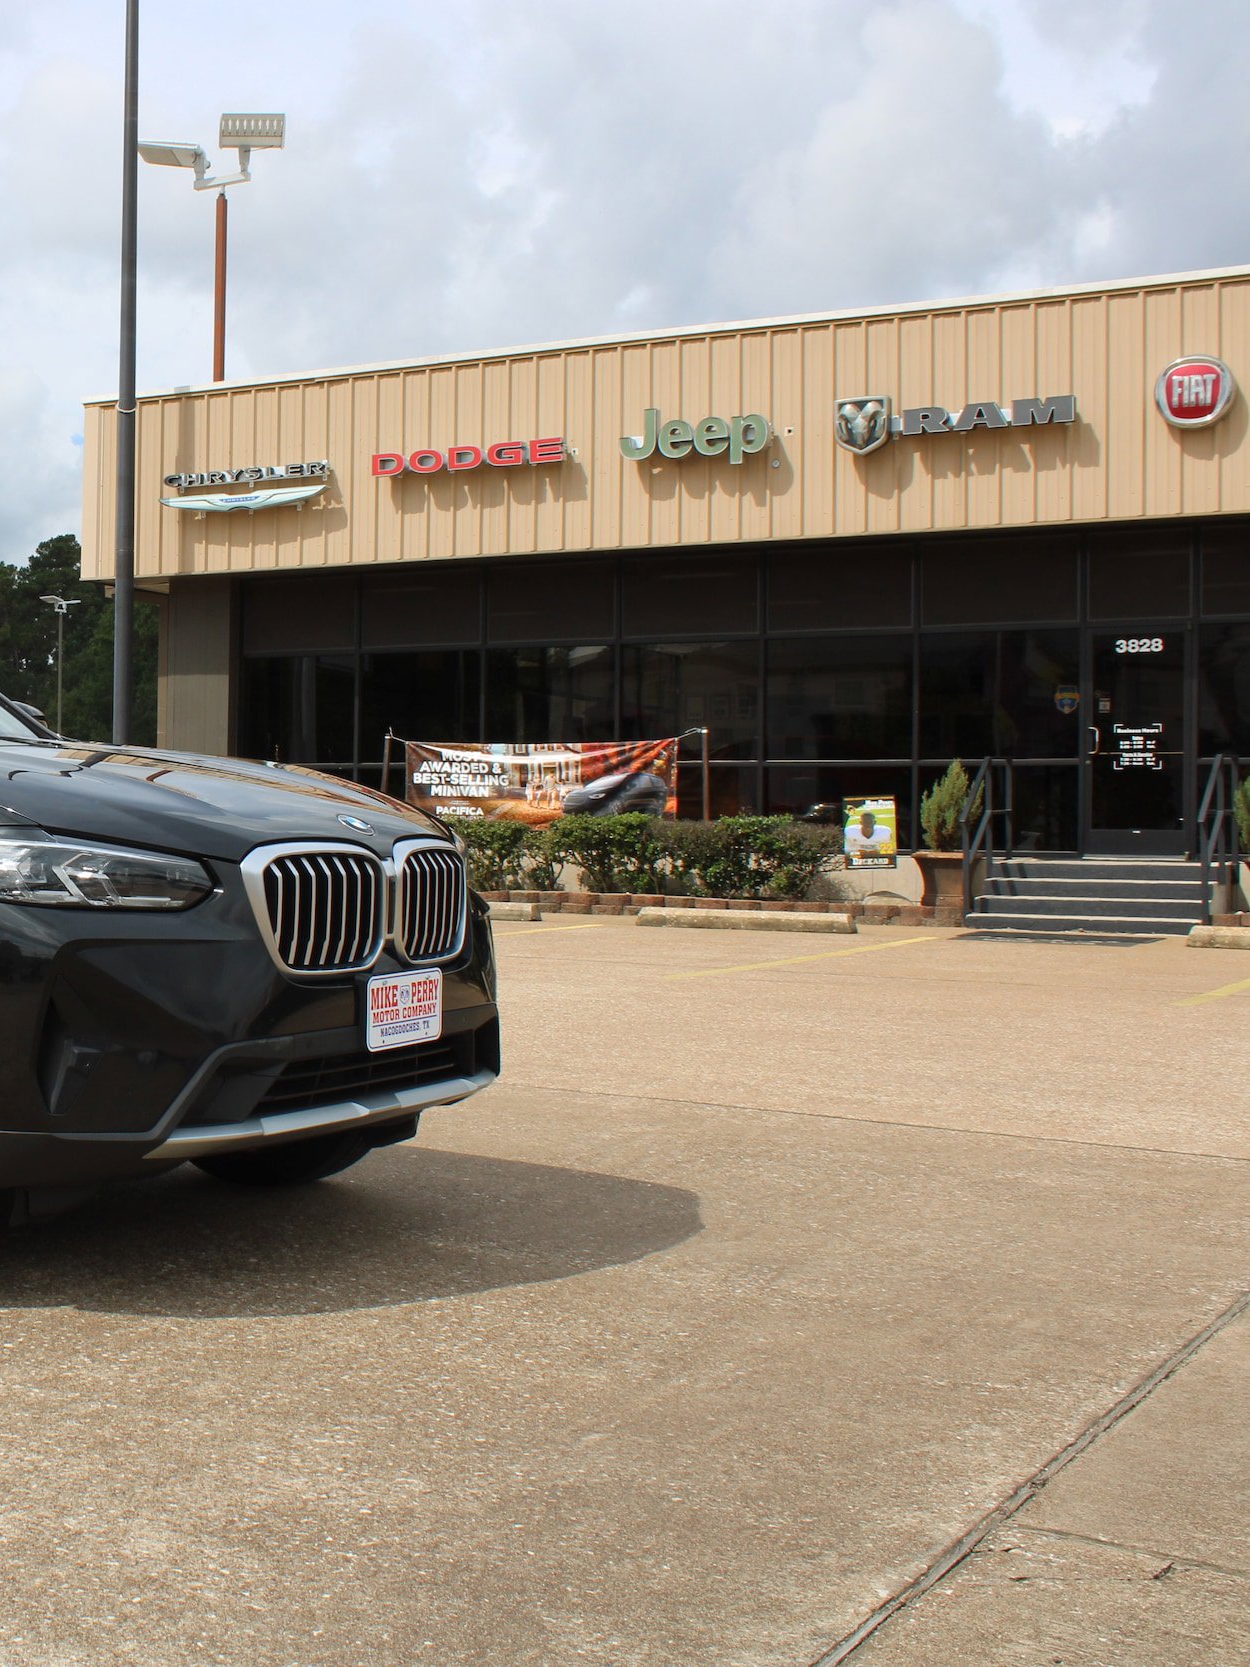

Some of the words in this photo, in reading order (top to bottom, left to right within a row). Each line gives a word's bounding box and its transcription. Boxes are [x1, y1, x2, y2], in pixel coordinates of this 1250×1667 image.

[1171, 373, 1217, 409] FIAT
[902, 395, 1076, 435] RAM
[619, 408, 772, 465] Jeep
[371, 437, 566, 477] DODGE
[164, 461, 327, 488] CHRYSLER
[1115, 637, 1163, 654] 3828
[419, 761, 489, 774] AWARDED
[492, 763, 502, 774] &
[413, 773, 509, 786] BEST-SELLING
[430, 785, 490, 798] MINIVAN
[436, 806, 484, 815] PACIFICA
[880, 844, 894, 854] 22
[371, 985, 398, 1010] MIKE
[411, 978, 439, 1004] PERRY
[372, 1009, 400, 1024] MOTOR
[402, 1003, 437, 1019] COMPANY
[423, 1020, 430, 1030] TX
